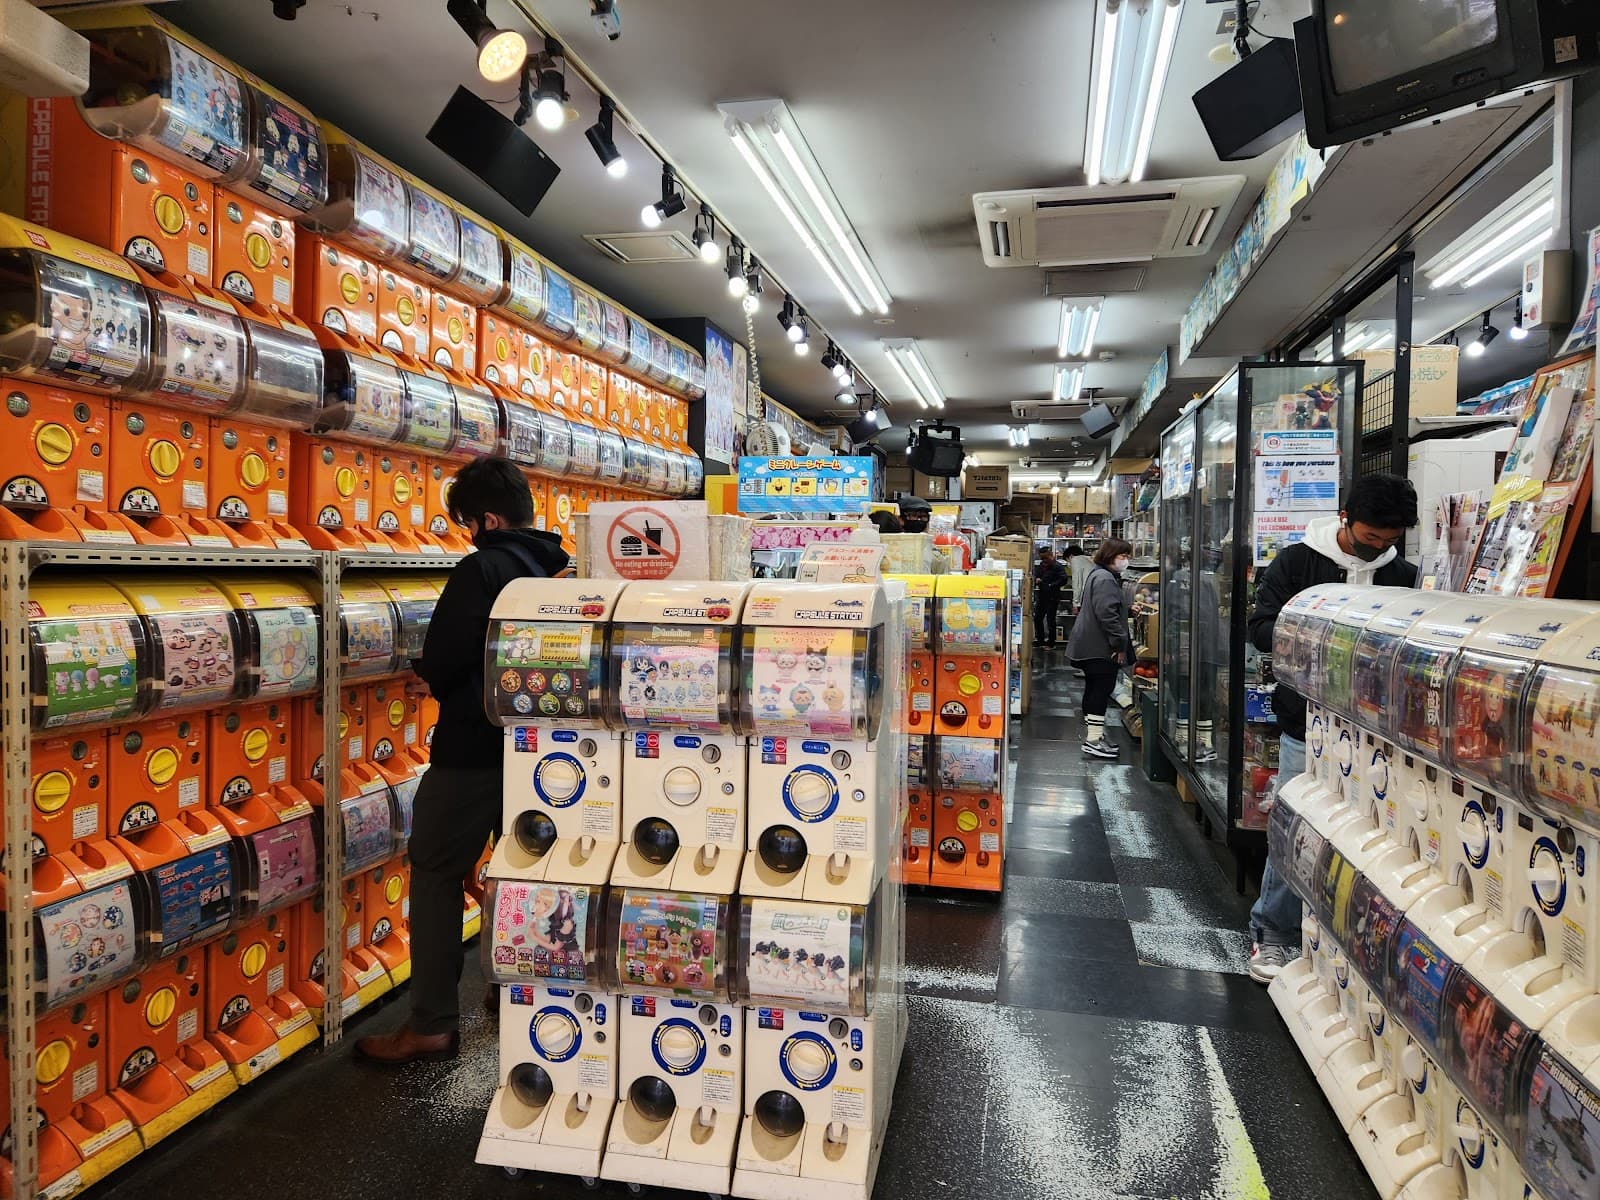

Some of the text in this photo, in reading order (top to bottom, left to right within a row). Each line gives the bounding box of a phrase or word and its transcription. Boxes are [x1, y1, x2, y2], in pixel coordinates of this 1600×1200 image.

[32, 99, 50, 225] CAPSULE STA
[768, 459, 841, 471] ミニクレーンゲーム
[649, 560, 674, 569] drinking
[538, 604, 582, 614] CAPSULE ST
[663, 608, 708, 617] CAPSULE ST
[795, 610, 862, 620] CAPSULE STATION
[1550, 1065, 1600, 1121] HELIBORNE COLLECT
